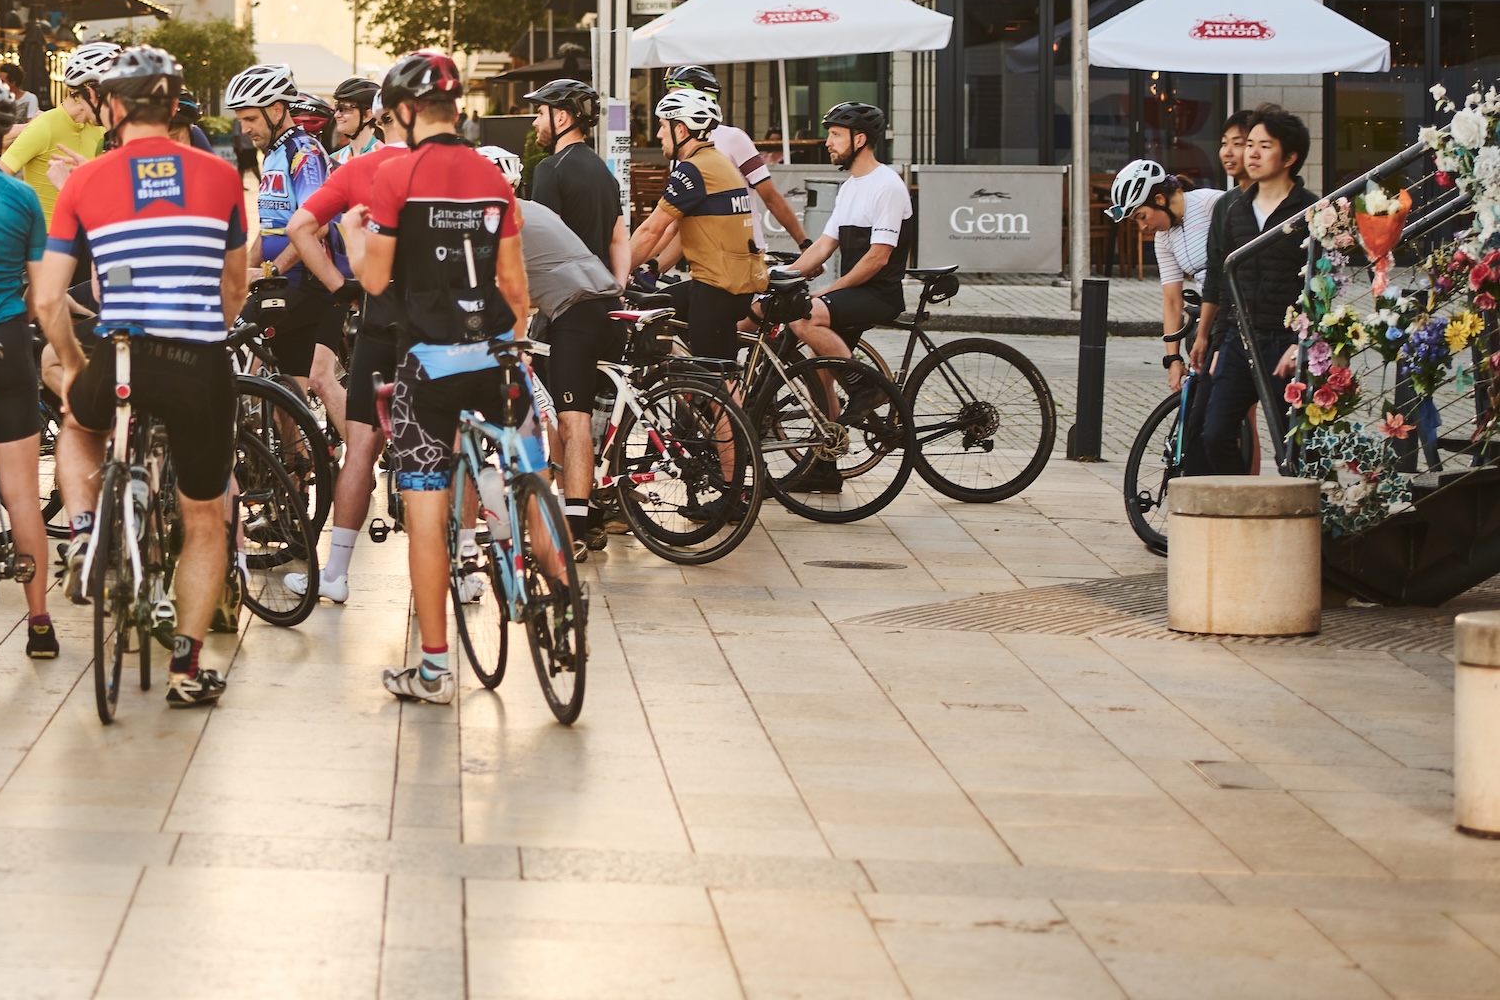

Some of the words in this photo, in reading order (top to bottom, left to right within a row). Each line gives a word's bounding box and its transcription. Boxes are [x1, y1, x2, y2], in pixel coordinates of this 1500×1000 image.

[1204, 23, 1259, 31] STELLA
[137, 161, 178, 180] KB
[141, 178, 176, 189] Kent
[137, 186, 181, 199] Blaxill
[429, 206, 485, 220] Lancaster
[429, 213, 482, 231] University
[950, 206, 1031, 234] Gem
[963, 234, 998, 242] exceptional
